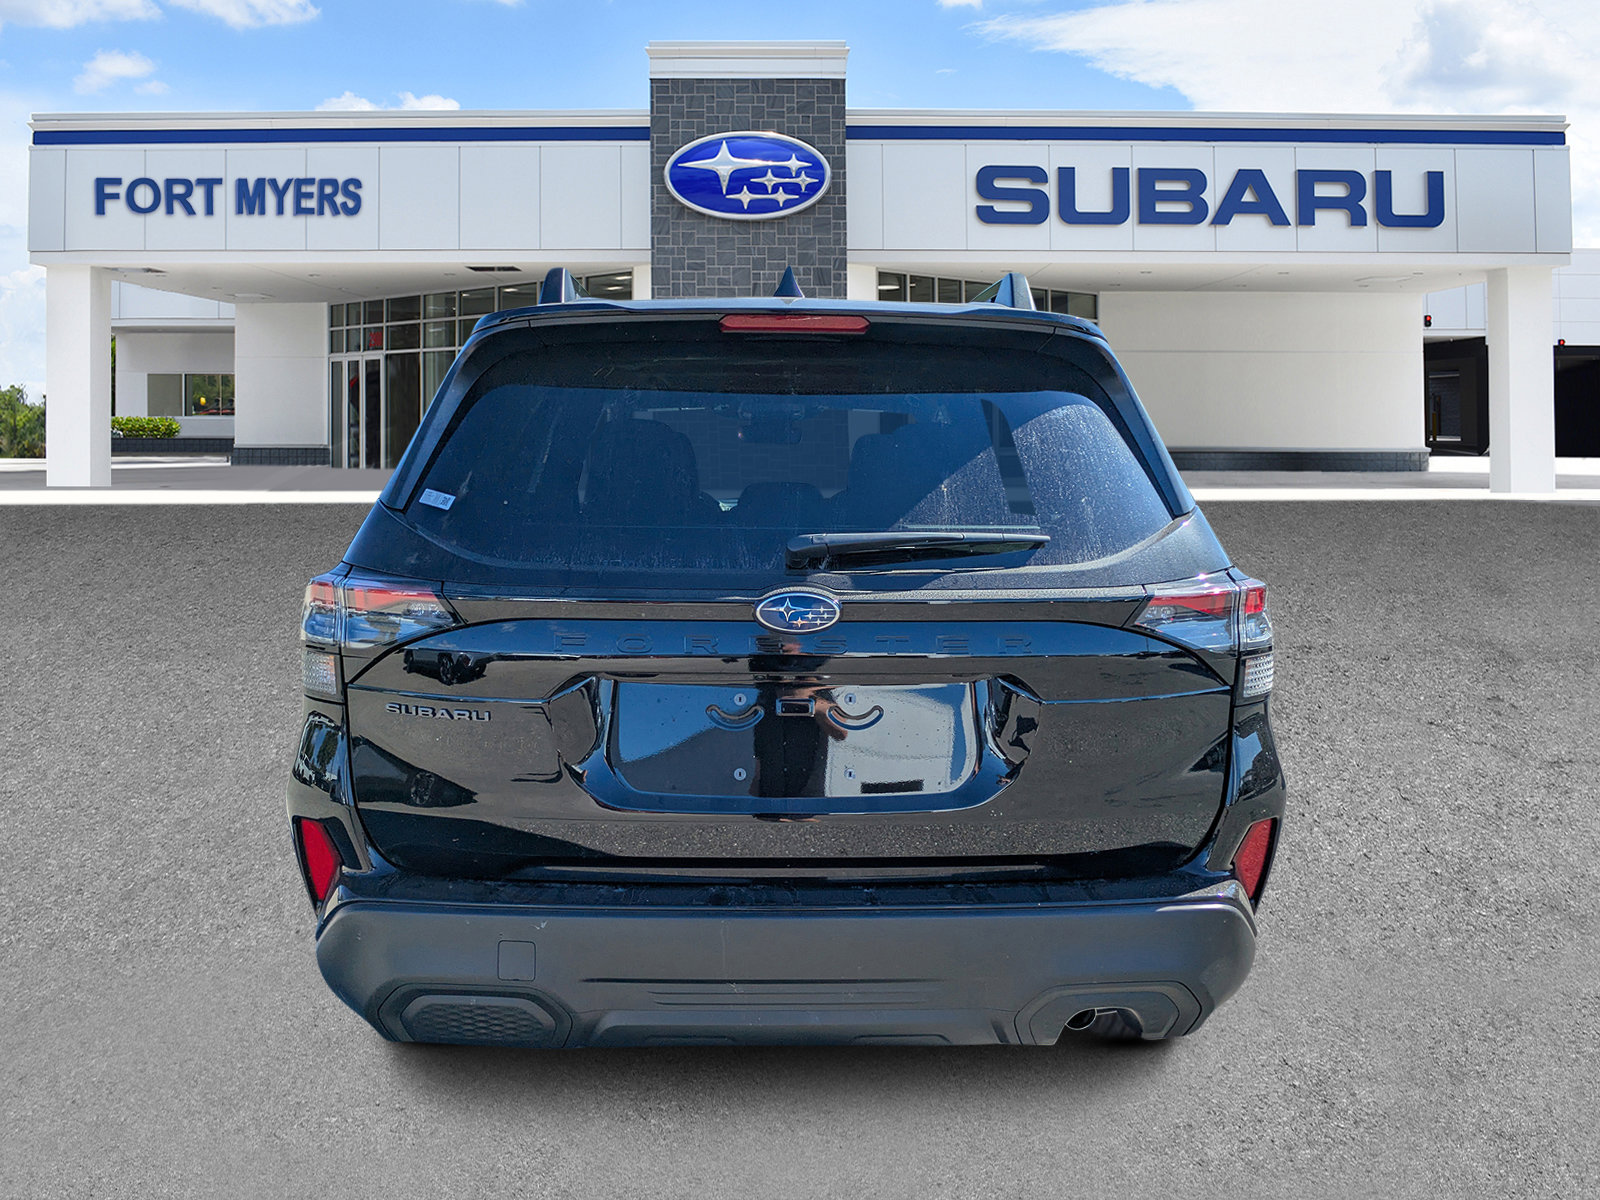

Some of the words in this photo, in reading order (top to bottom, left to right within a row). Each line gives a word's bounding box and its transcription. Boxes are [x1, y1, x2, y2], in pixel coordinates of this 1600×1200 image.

[94, 177, 223, 216] FORT
[235, 177, 362, 216] MYERS
[975, 164, 1446, 228] SUBARU
[553, 632, 1032, 655] FORESTER
[385, 702, 492, 722] SUBARU
